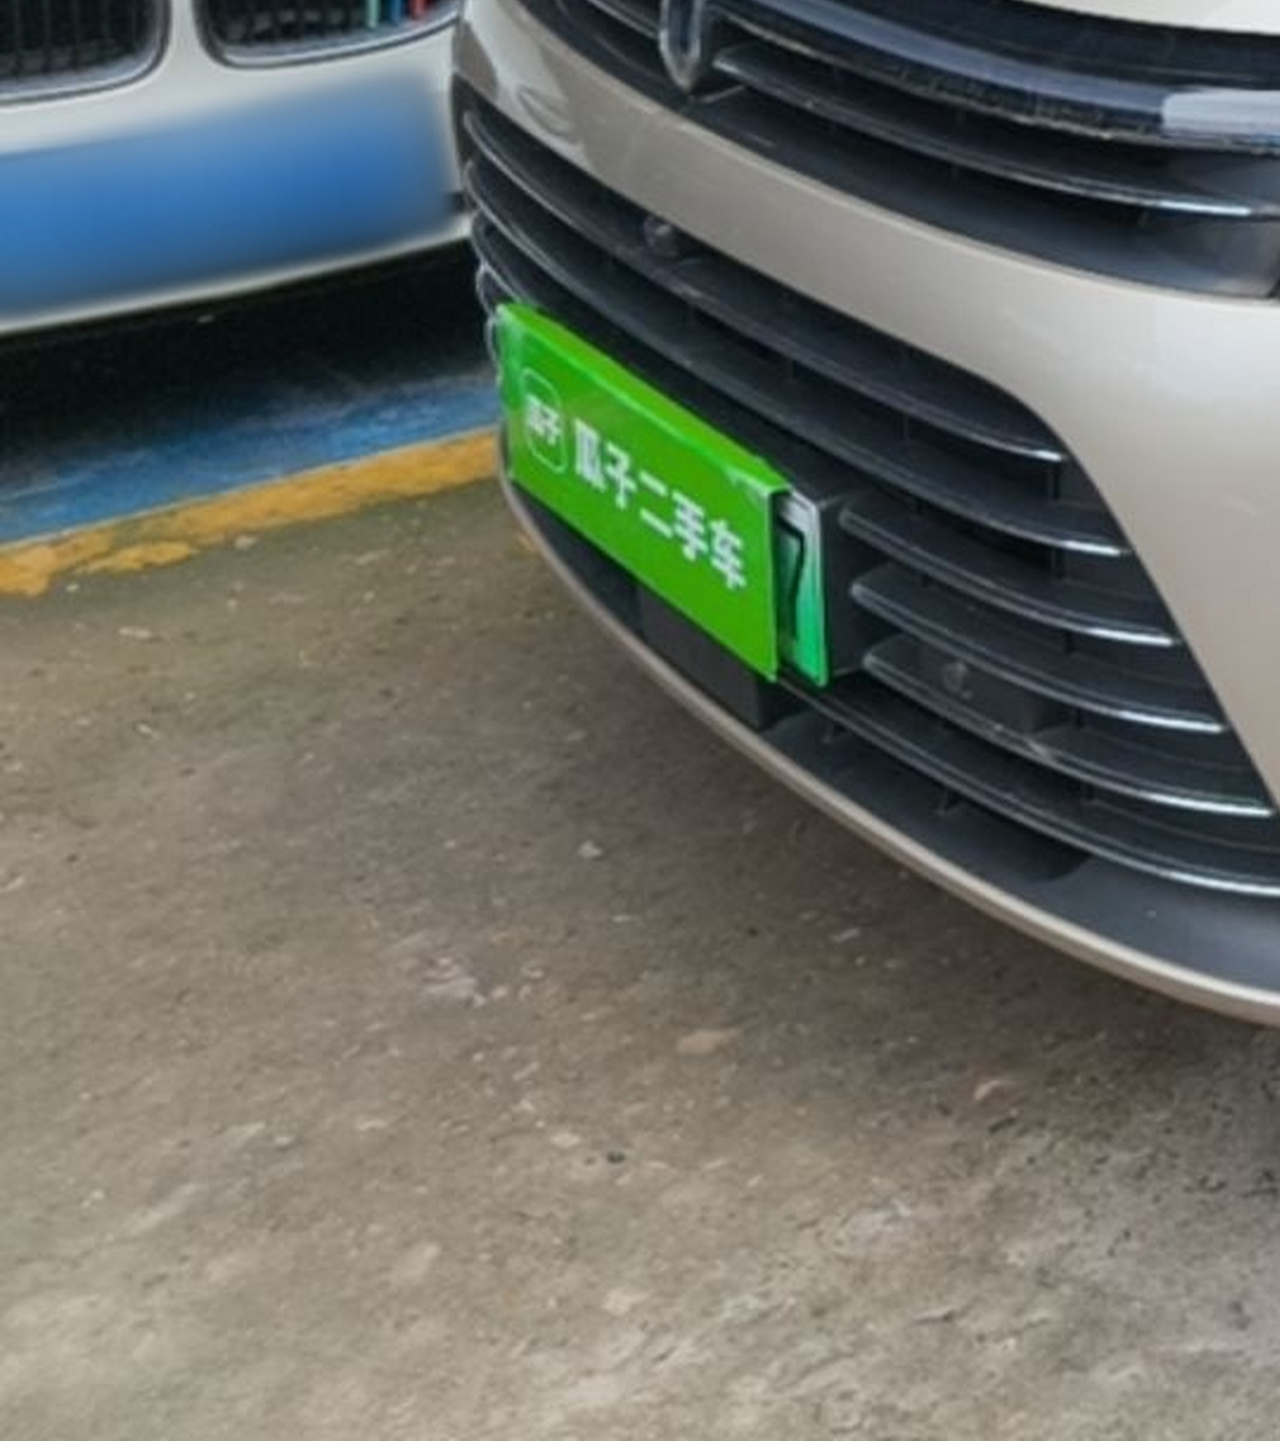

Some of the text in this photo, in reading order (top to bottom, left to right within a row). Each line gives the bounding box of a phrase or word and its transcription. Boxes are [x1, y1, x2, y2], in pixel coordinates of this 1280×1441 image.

[574, 417, 746, 591] 瓜子二手车
